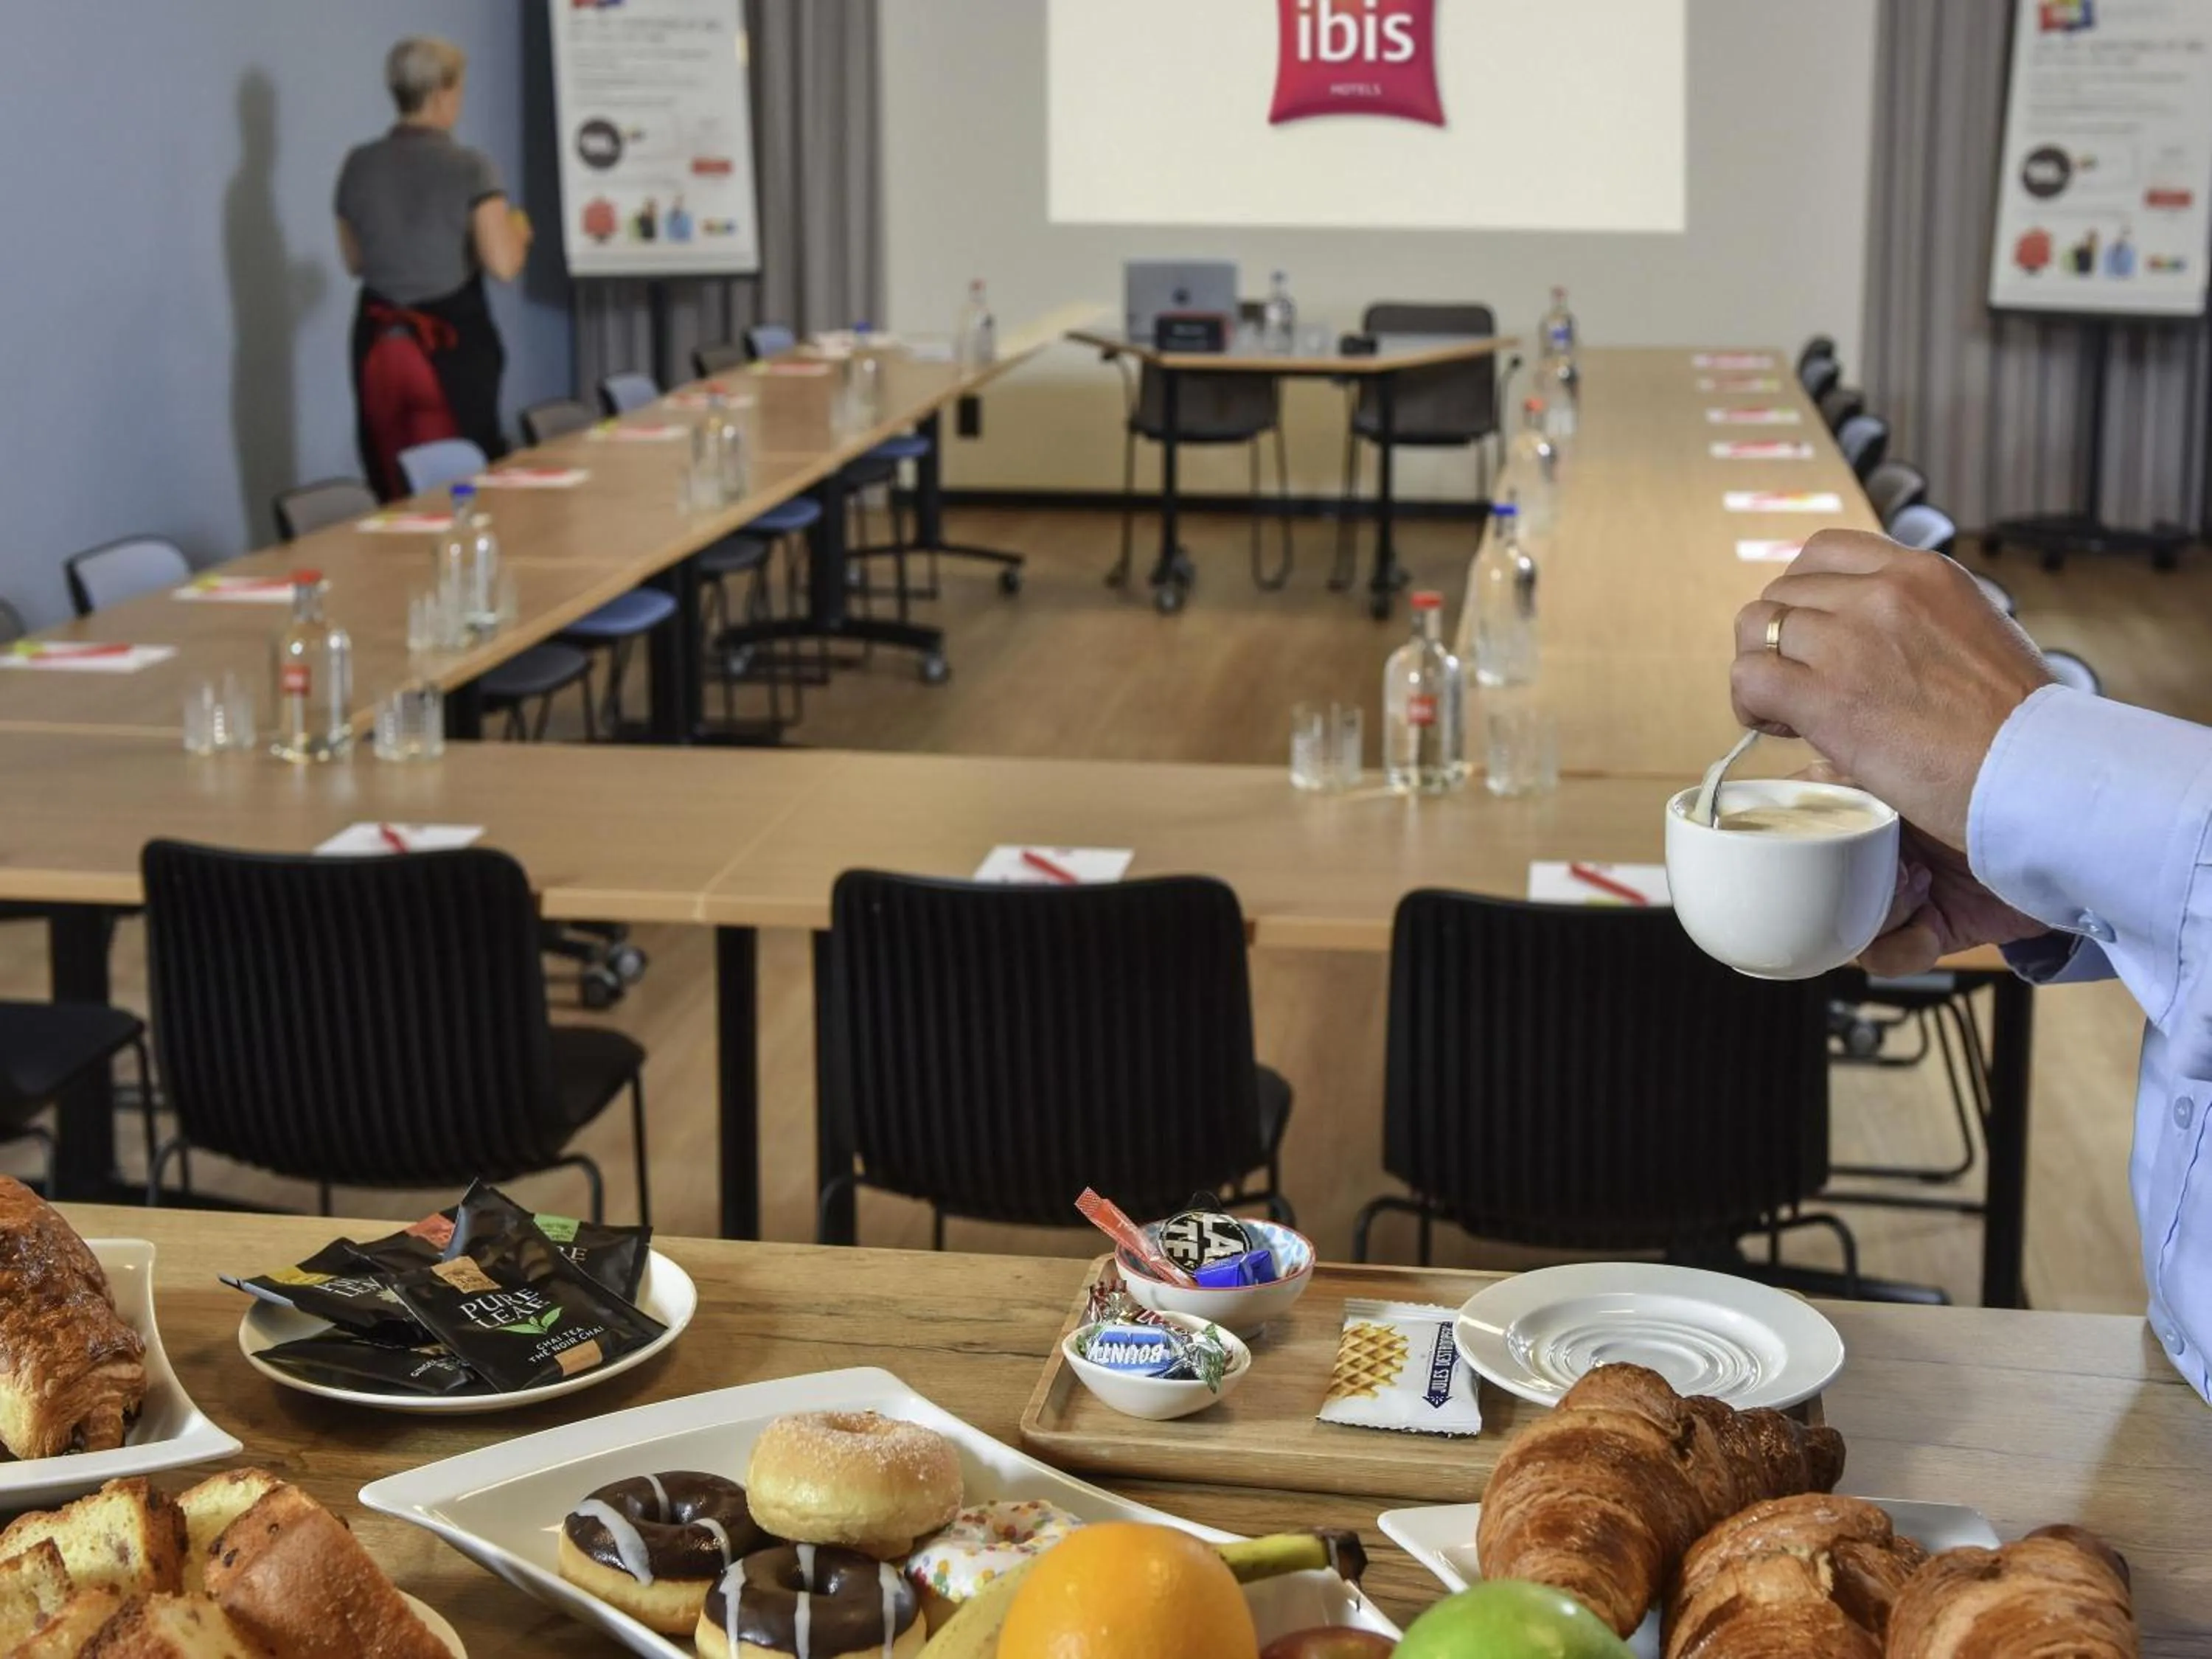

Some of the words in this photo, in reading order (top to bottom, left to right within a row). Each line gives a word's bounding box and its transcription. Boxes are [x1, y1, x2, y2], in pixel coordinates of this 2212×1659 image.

[1298, 0, 1415, 62] ibis
[1330, 83, 1381, 95] HOTELS
[459, 1288, 538, 1320] PURE
[474, 1299, 551, 1329] LEAF
[536, 1335, 563, 1351] CHAI
[562, 1326, 585, 1338] TEA
[551, 1336, 579, 1352] NOIR
[579, 1325, 605, 1340] CHAI
[1087, 1338, 1165, 1364] BOUNTY
[1431, 1368, 1450, 1394] JULES
